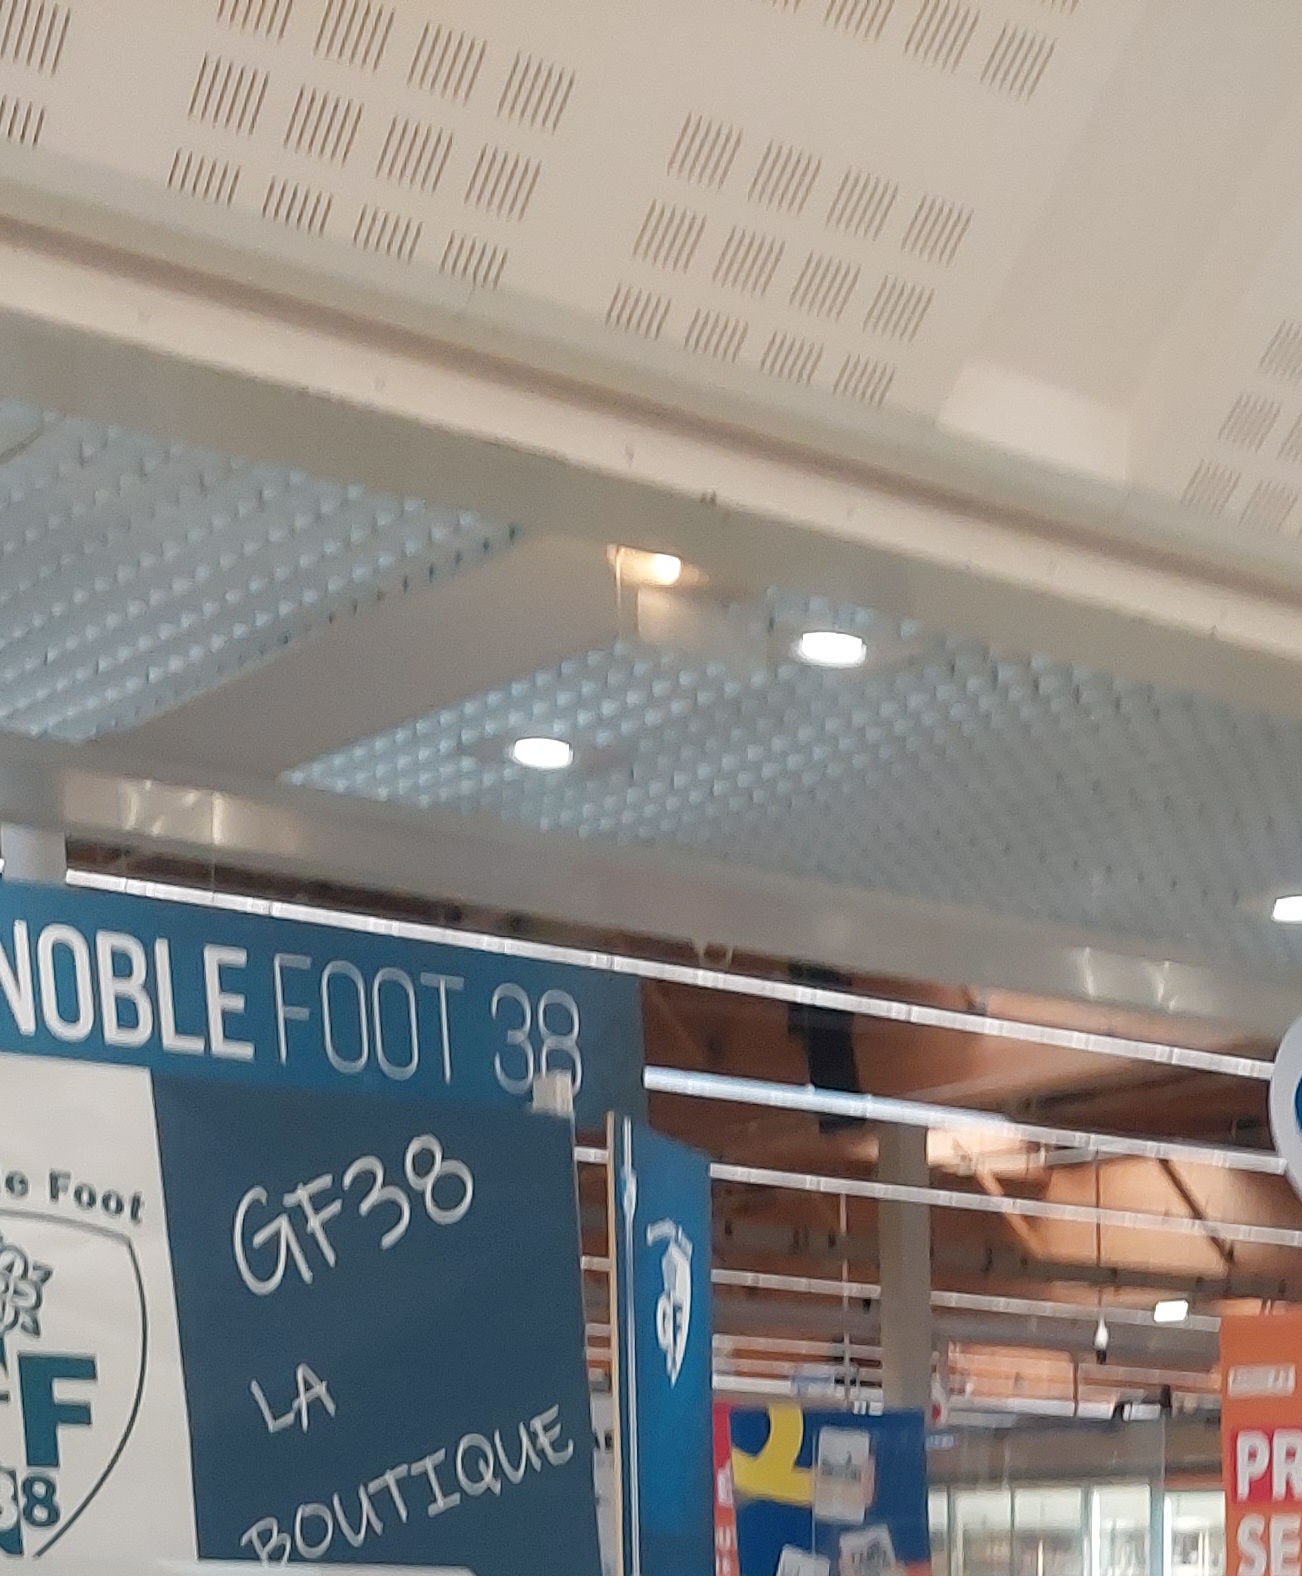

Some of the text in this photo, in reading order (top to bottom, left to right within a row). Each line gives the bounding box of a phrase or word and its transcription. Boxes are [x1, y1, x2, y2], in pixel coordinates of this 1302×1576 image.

[272, 952, 465, 1084] FOOT
[490, 982, 583, 1096] 38
[49, 1168, 145, 1223] Foot
[232, 1133, 474, 1296] GF38
[250, 1362, 337, 1434] LA
[241, 1404, 575, 1567] BOUTIQUE
